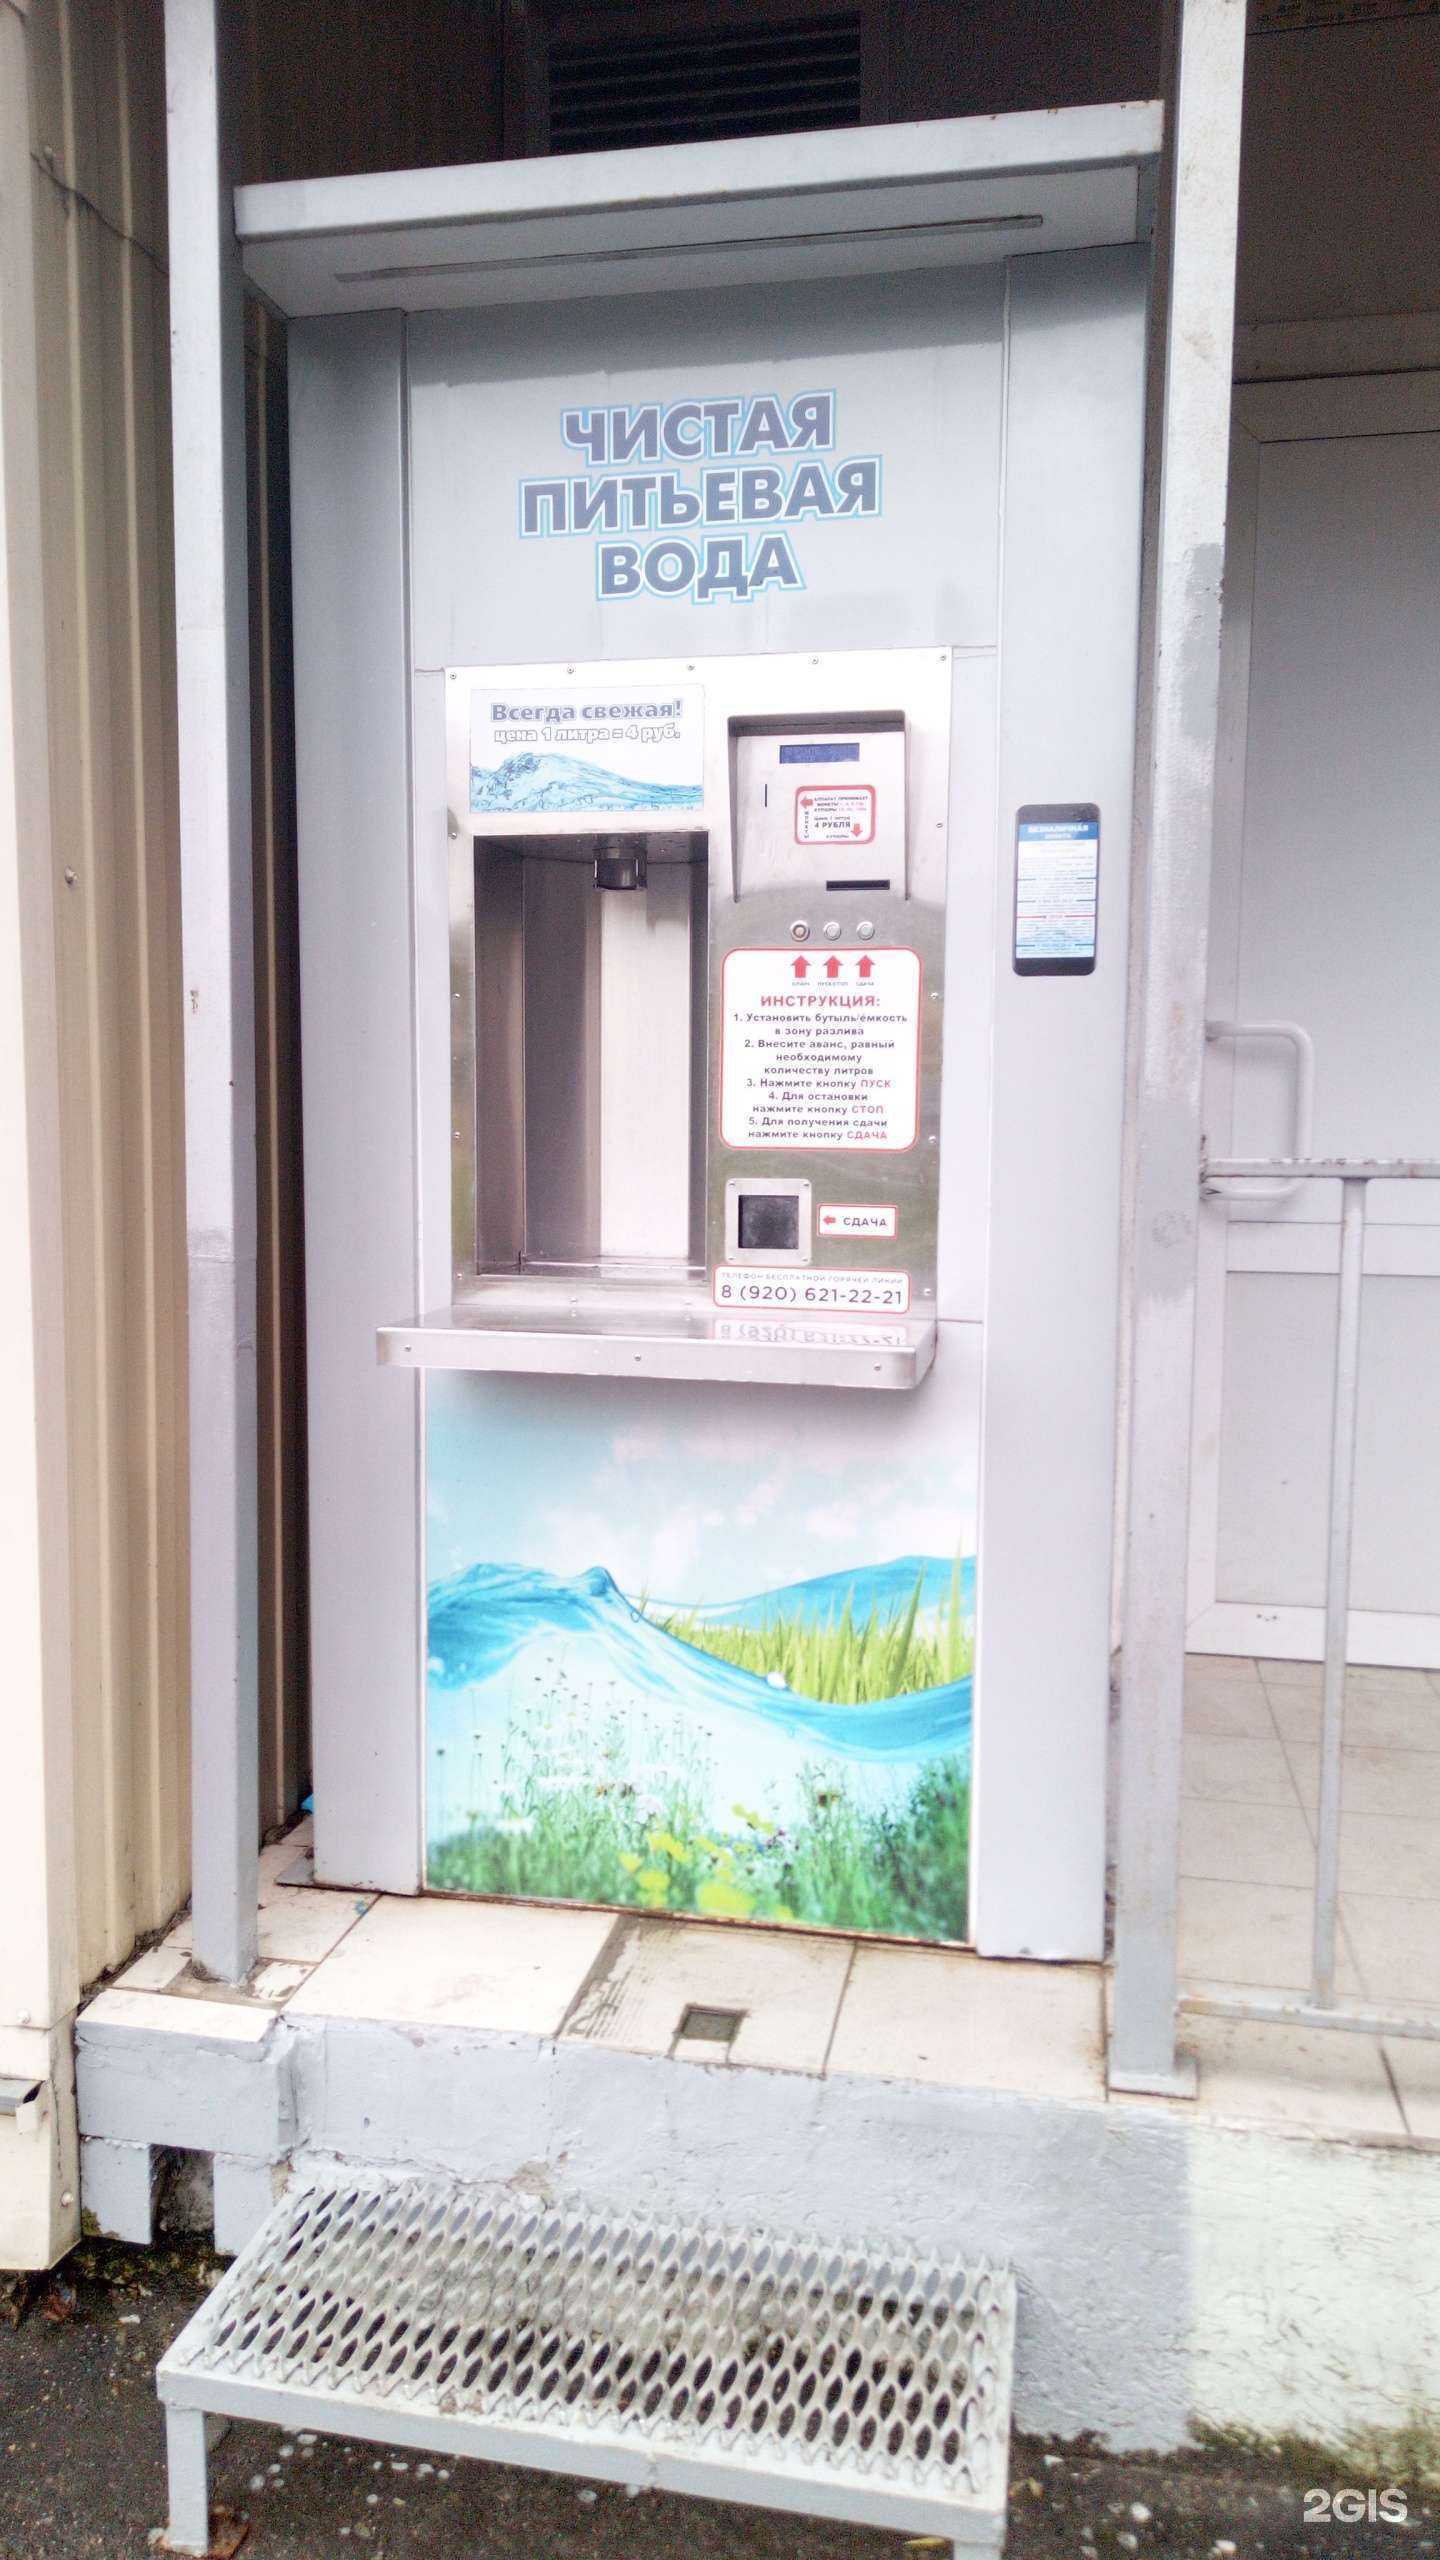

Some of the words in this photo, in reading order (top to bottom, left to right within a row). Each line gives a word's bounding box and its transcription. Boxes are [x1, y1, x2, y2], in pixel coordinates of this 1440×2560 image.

[561, 388, 836, 467] ЧИСТАЯ
[519, 454, 882, 539] ПИТЬЕВАЯ
[596, 530, 806, 605] ВОДА
[491, 703, 577, 724] Всегда
[581, 698, 683, 720] свежая!
[494, 729, 538, 744] цена
[541, 727, 552, 741] 1
[555, 728, 610, 744] литра
[625, 724, 638, 739] 4
[641, 723, 681, 743] руб.
[760, 995, 880, 1008] ИНСТРУКЦИЯ:
[734, 1014, 742, 1022] 1.
[746, 1013, 811, 1022] Установить
[785, 1028, 811, 1037] зону
[815, 1028, 864, 1037] разлива
[744, 1040, 753, 1048] 2.
[758, 1040, 806, 1048] Внесите
[809, 1041, 847, 1050] аванс,
[851, 1040, 895, 1049] равный
[776, 1053, 862, 1064] необходимому
[764, 1066, 829, 1076] количеству
[834, 1067, 873, 1076] литров
[746, 1078, 756, 1087] 3.
[760, 1079, 812, 1088] Нажмите
[816, 1081, 856, 1090] кнопку
[861, 1079, 891, 1088] ПУСК
[768, 1092, 778, 1100] 4.
[782, 1092, 804, 1101] Для
[753, 1106, 803, 1114] нажмите
[807, 1106, 847, 1115] кнопку
[852, 1105, 884, 1114] СТОП
[748, 1117, 758, 1125] 5.
[761, 1117, 784, 1126] Для
[787, 1118, 849, 1127] получения
[853, 1119, 887, 1127] сдачи
[748, 1131, 799, 1139] нажмите
[803, 1132, 843, 1141] кнопку
[847, 1131, 887, 1140] СДАЧА
[843, 1217, 888, 1227] СДАЧА
[721, 1284, 732, 1298] 8
[740, 1285, 796, 1302] (920)
[805, 1287, 901, 1304] 621-22-21
